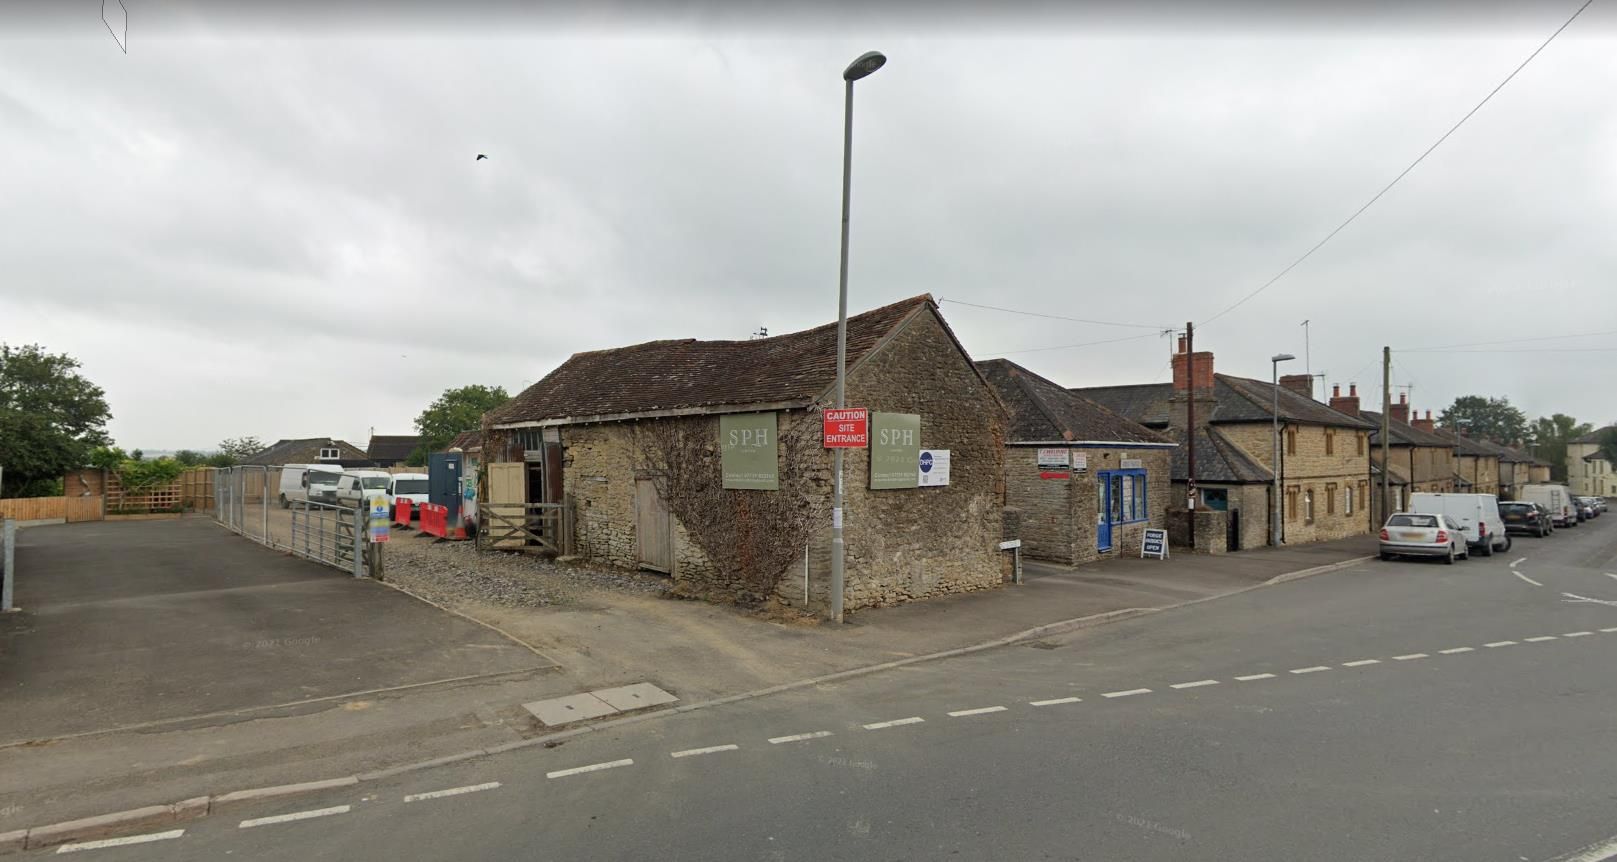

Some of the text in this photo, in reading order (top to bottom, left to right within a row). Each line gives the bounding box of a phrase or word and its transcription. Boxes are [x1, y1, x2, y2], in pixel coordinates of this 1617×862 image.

[826, 411, 865, 420] CAUTION
[838, 424, 855, 433] SITE
[729, 428, 768, 447] SPH
[826, 434, 866, 443] ENTRANCE
[880, 429, 913, 446] SPH
